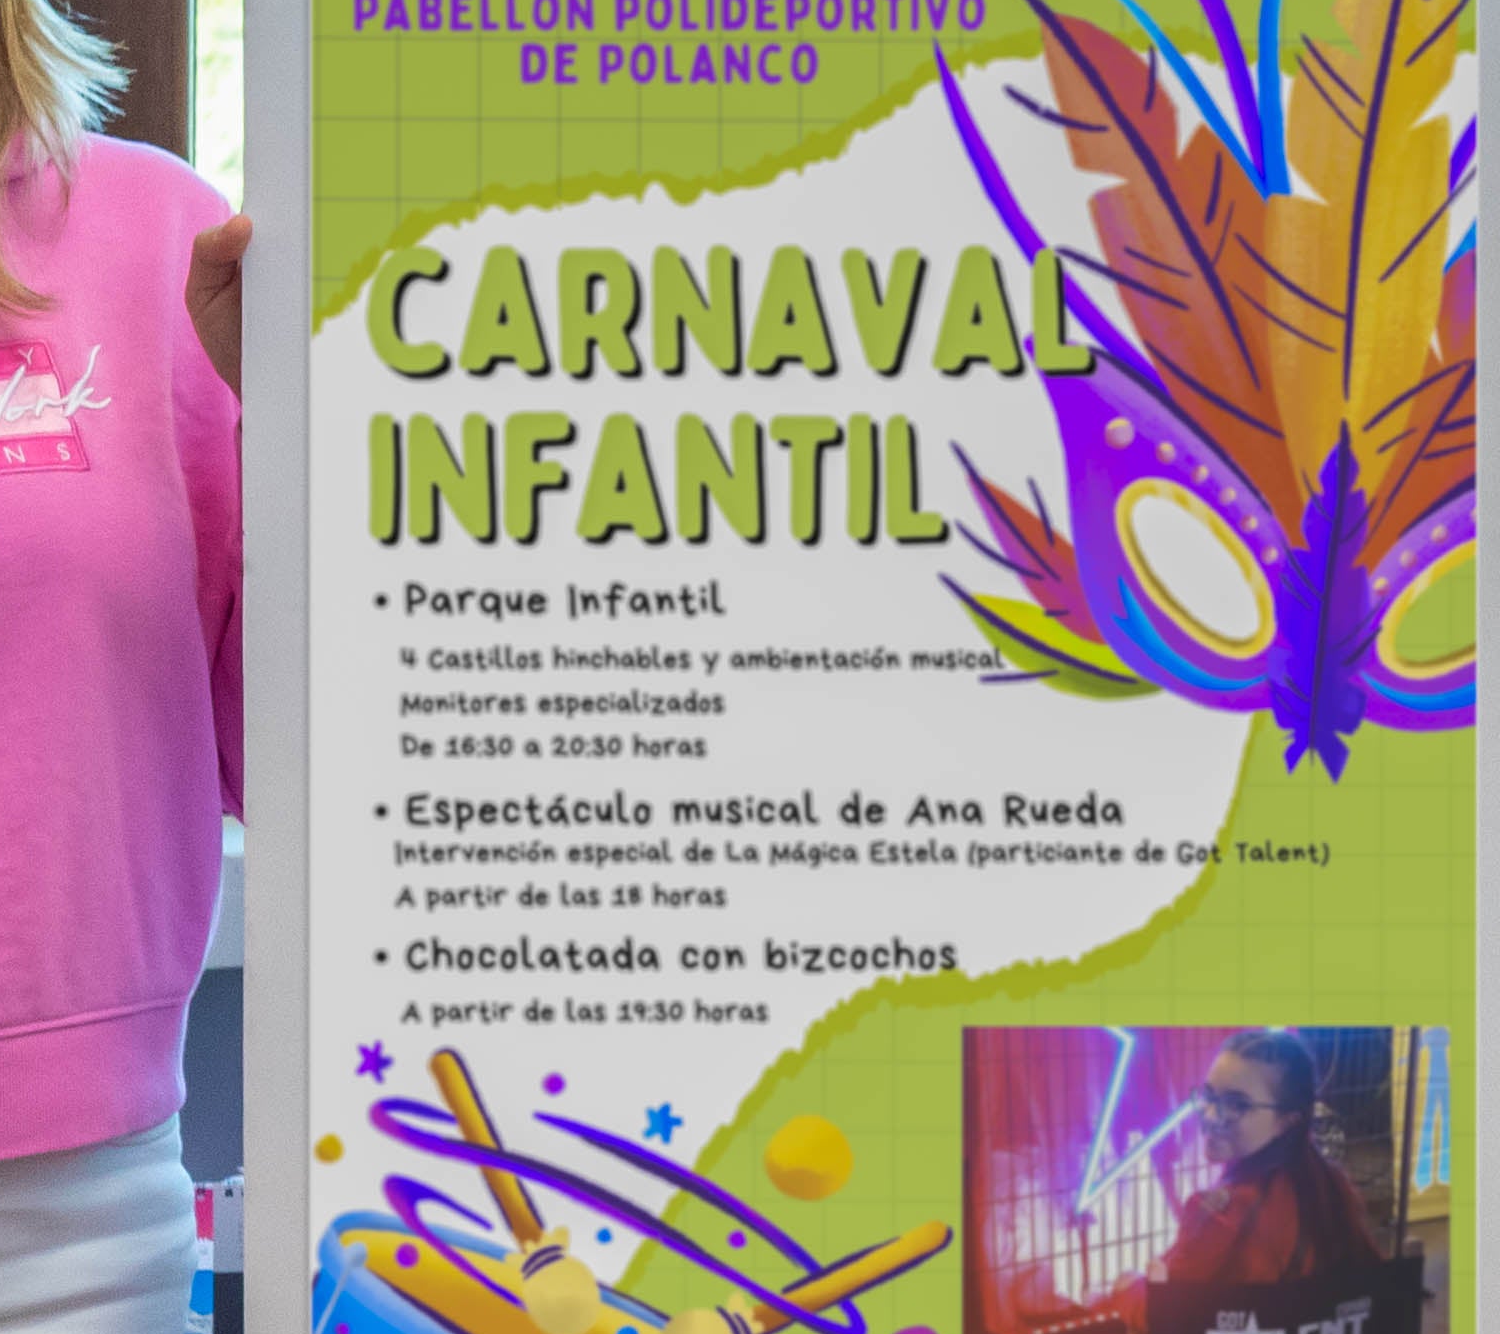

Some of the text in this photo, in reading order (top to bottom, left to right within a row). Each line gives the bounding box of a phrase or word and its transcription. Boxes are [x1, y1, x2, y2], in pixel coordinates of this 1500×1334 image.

[520, 42, 820, 85] DE POLANCO
[366, 244, 1098, 381] CARNAVAL
[367, 411, 951, 546] INFANTIL
[405, 581, 727, 621] Parque Infantil
[426, 646, 544, 671] Castillos
[551, 646, 693, 671] hinchables
[701, 654, 720, 675] y
[728, 644, 901, 672] ambientación
[909, 646, 1008, 671] musical
[399, 690, 726, 718] Monitores especializados
[399, 734, 708, 758] De 16:30 a 20:30 horas
[405, 791, 1125, 833] Espectáculo musical de Ana Rueda
[393, 839, 557, 865] Intervención
[565, 841, 676, 867] especial
[682, 841, 716, 864] de
[724, 842, 761, 864] La
[768, 840, 860, 868] Mágica
[867, 840, 959, 865] Estela
[1133, 840, 1168, 864] de
[1175, 841, 1224, 866] Got
[1233, 839, 1333, 868] Talent)
[395, 884, 729, 910] A partir de las 18 horas
[405, 936, 960, 974] Chocolatada con bizcochos
[401, 1000, 771, 1027] A partir de las 19:30 horas
